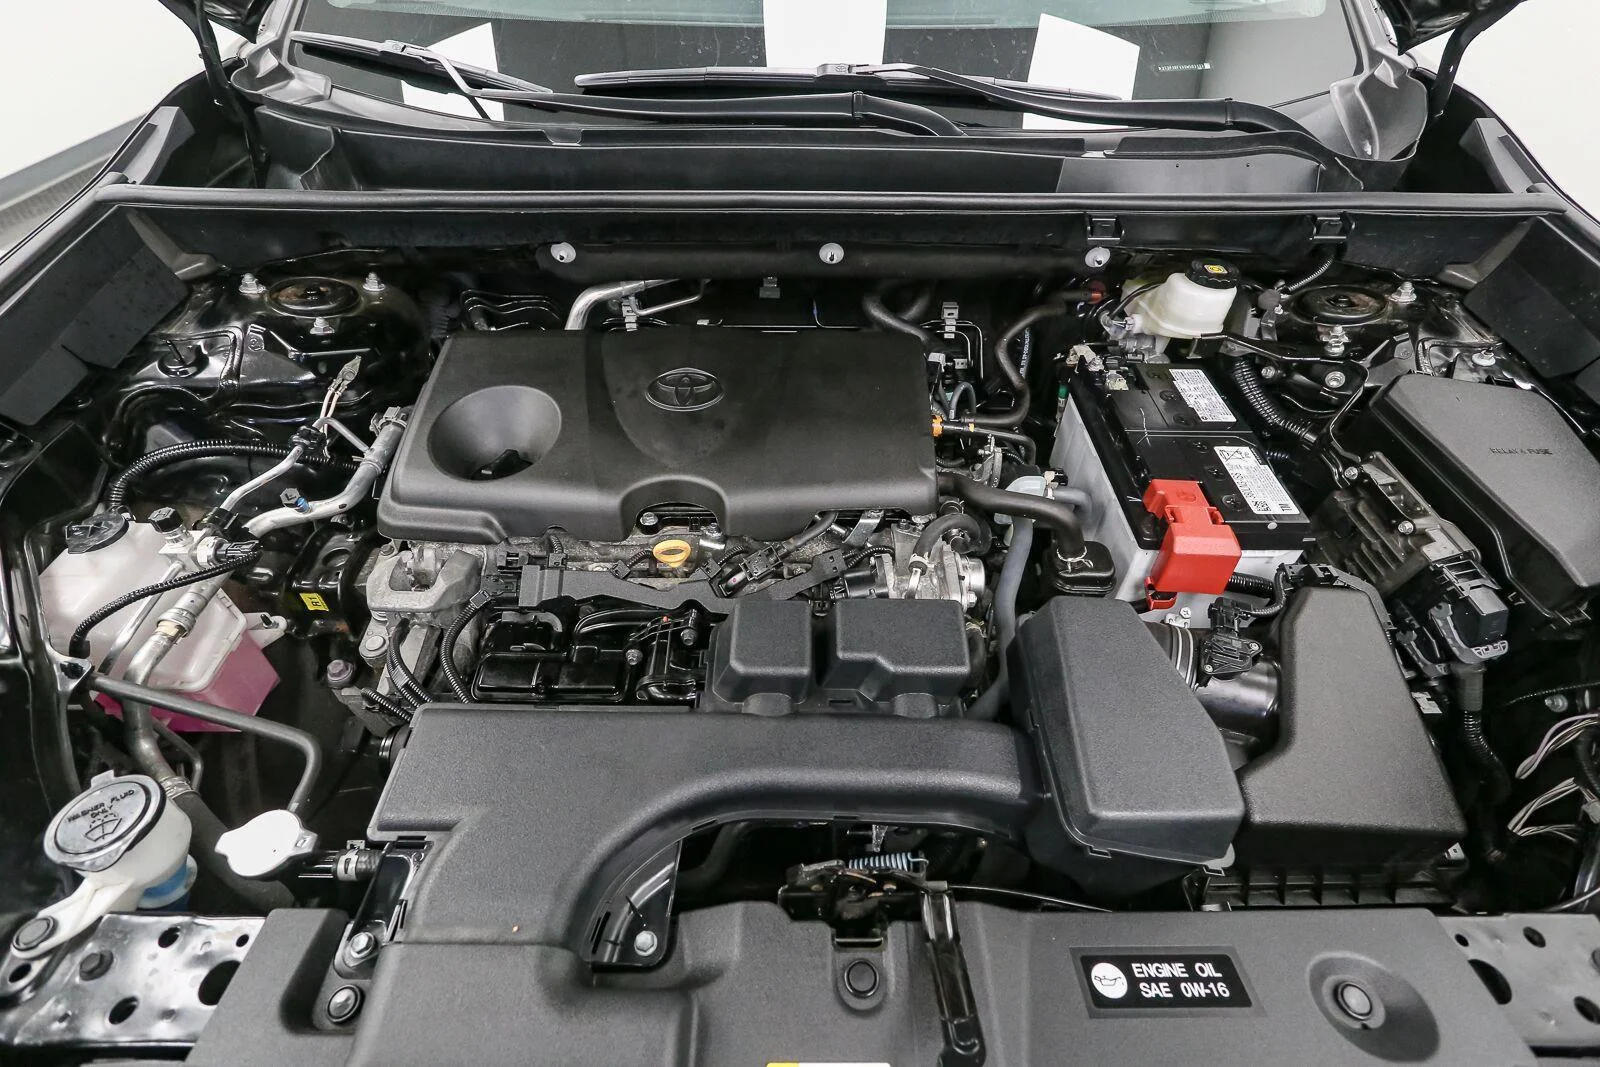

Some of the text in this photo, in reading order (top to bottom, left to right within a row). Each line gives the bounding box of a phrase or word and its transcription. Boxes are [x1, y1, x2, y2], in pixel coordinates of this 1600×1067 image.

[1489, 447, 1518, 455] RELAY
[68, 789, 134, 822] WASHER FLUID
[91, 805, 113, 818] ONLY
[1131, 962, 1223, 978] ENGINE OIL
[1139, 982, 1231, 998] SAE 0W-16
